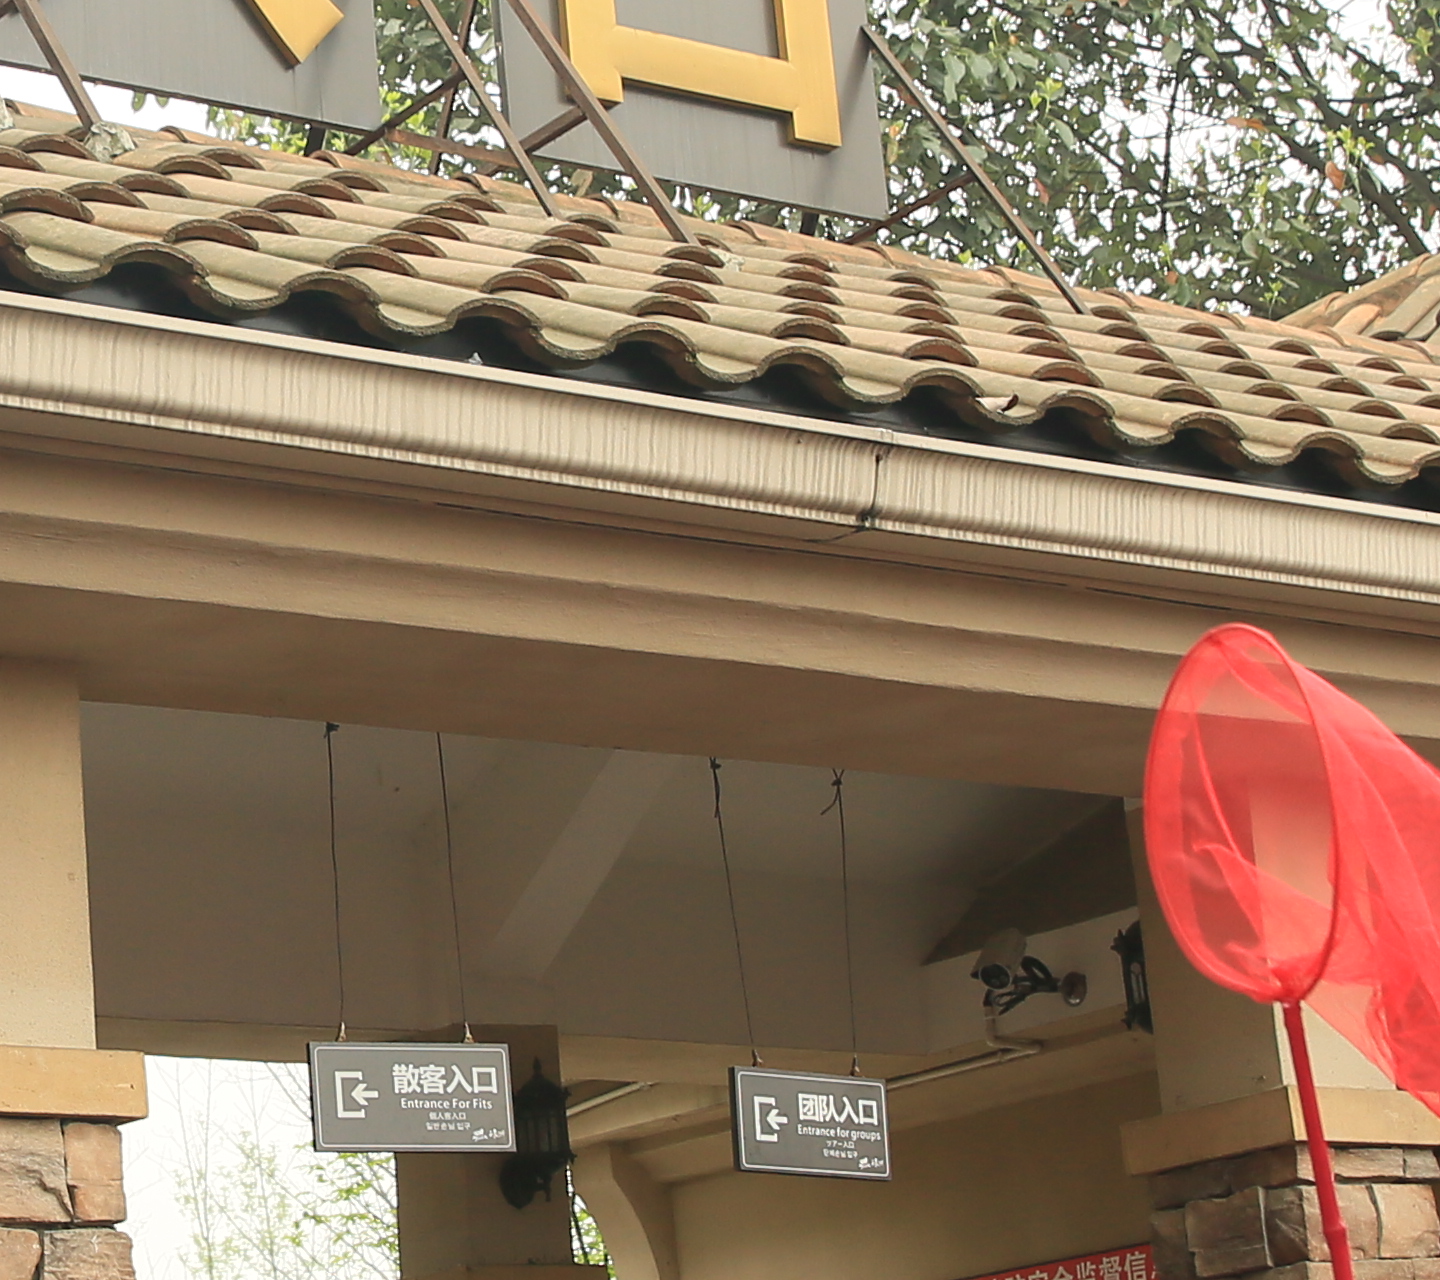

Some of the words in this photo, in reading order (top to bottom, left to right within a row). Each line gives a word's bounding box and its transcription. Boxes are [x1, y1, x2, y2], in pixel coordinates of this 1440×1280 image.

[392, 1064, 498, 1095] 散客入口
[400, 1097, 450, 1109] Entrance
[452, 1098, 470, 1109] For
[472, 1098, 493, 1110] Fits
[798, 1093, 878, 1126] 团队入口
[797, 1124, 836, 1137] Entrance
[837, 1127, 850, 1138] for
[851, 1129, 882, 1142] groups
